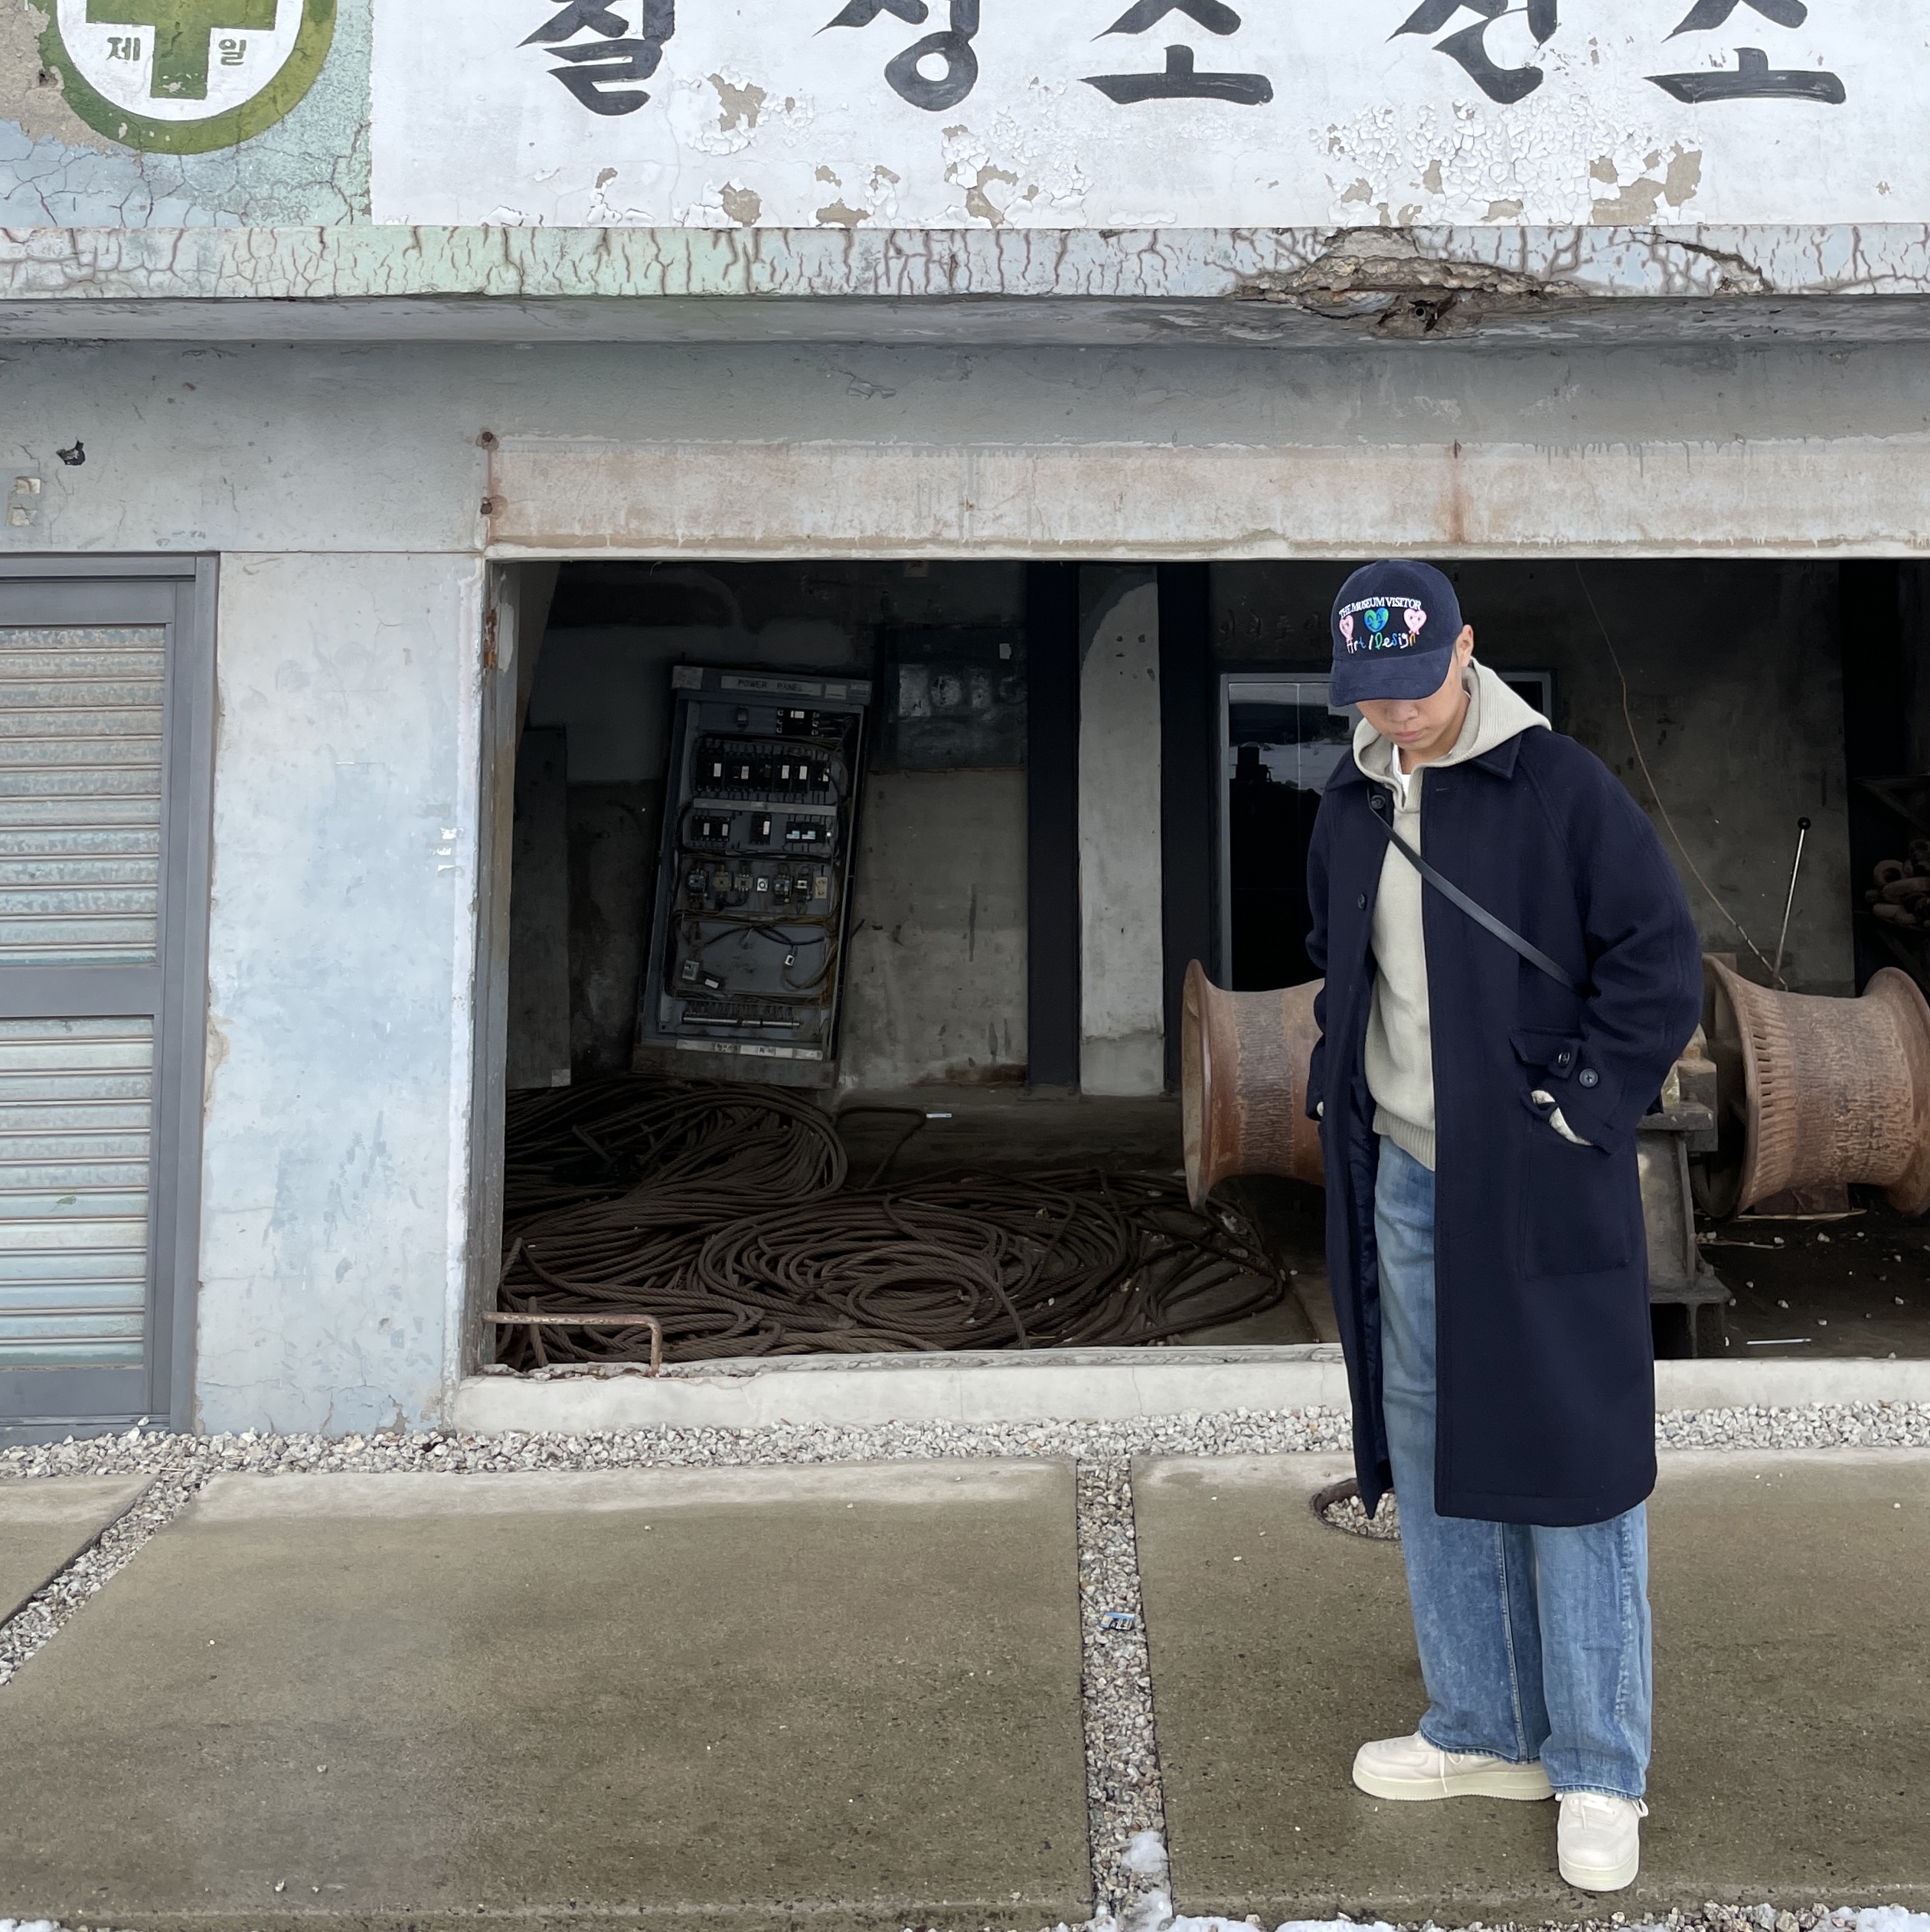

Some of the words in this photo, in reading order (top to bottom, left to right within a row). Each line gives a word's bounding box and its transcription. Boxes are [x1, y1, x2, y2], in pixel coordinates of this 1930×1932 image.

[1338, 604, 1351, 619] THE
[1351, 597, 1384, 613] MUSEUM
[1385, 597, 1422, 610] VISITOR
[737, 678, 768, 688] POWER
